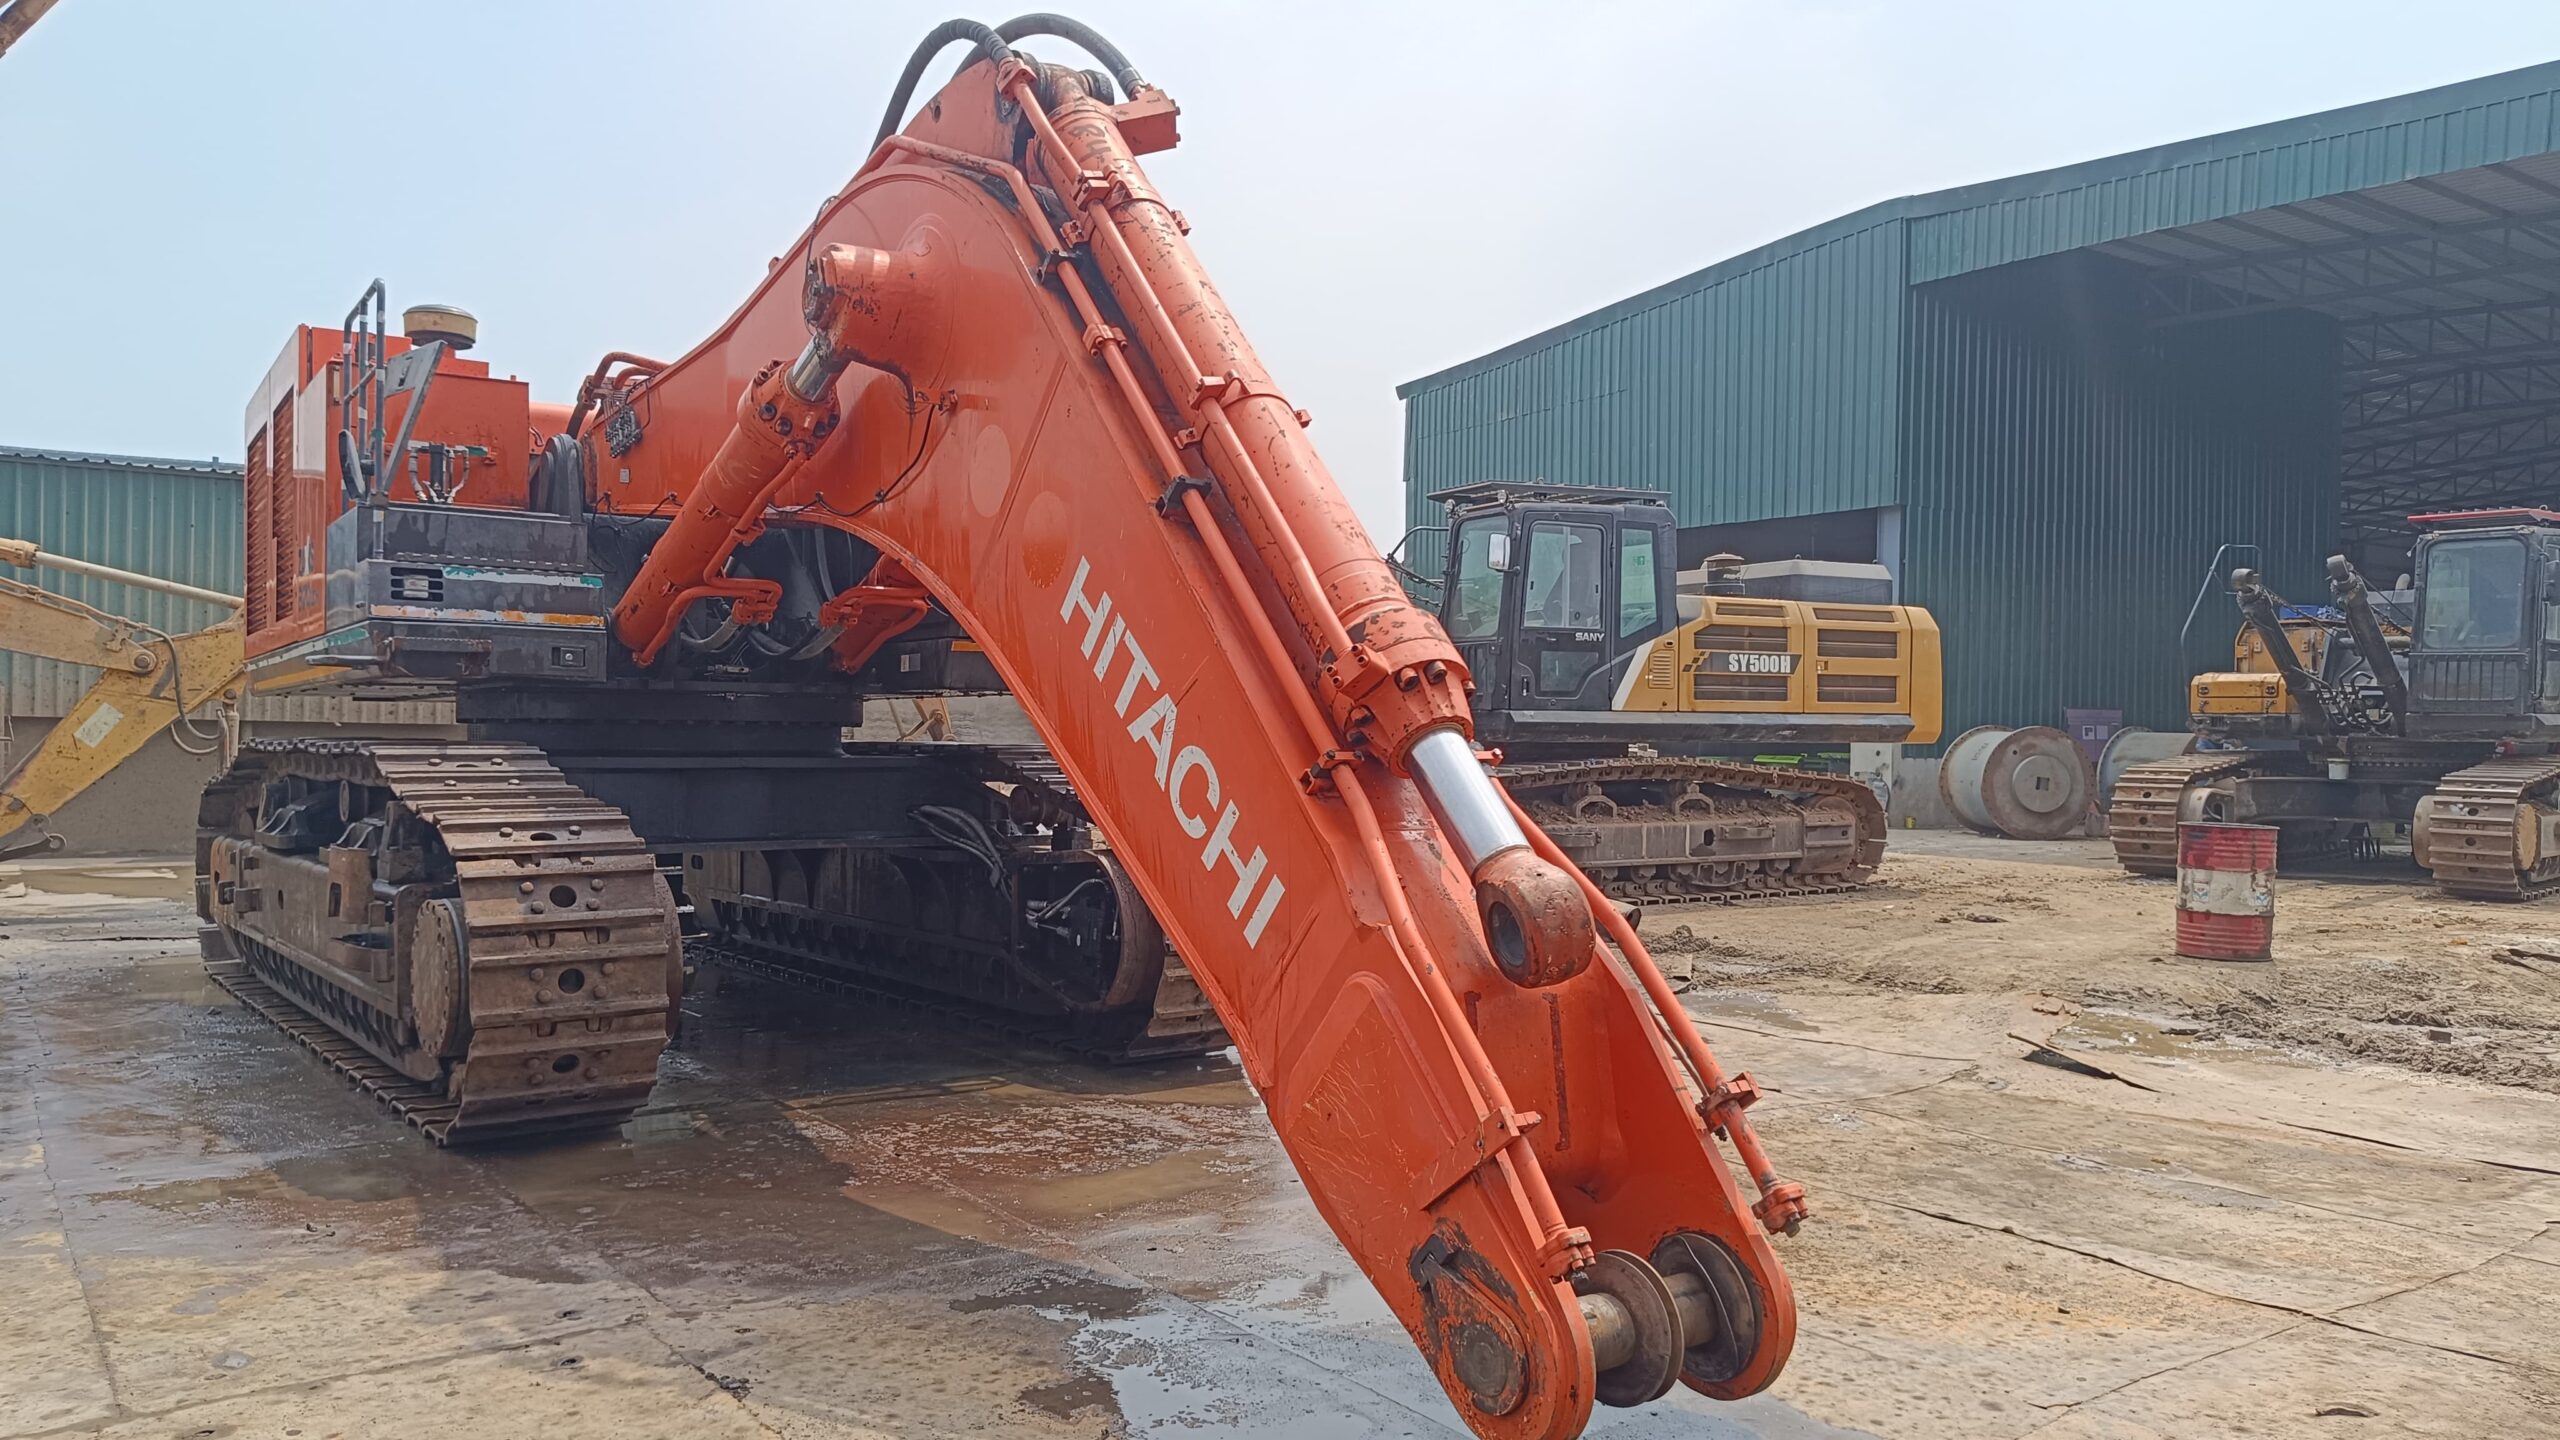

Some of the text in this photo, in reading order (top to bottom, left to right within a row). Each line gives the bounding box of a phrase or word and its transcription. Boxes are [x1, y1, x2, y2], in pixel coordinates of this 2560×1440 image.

[1575, 632, 1605, 642] SANY
[1728, 653, 1791, 673] SY500H
[1060, 556, 1285, 949] HITACHI
